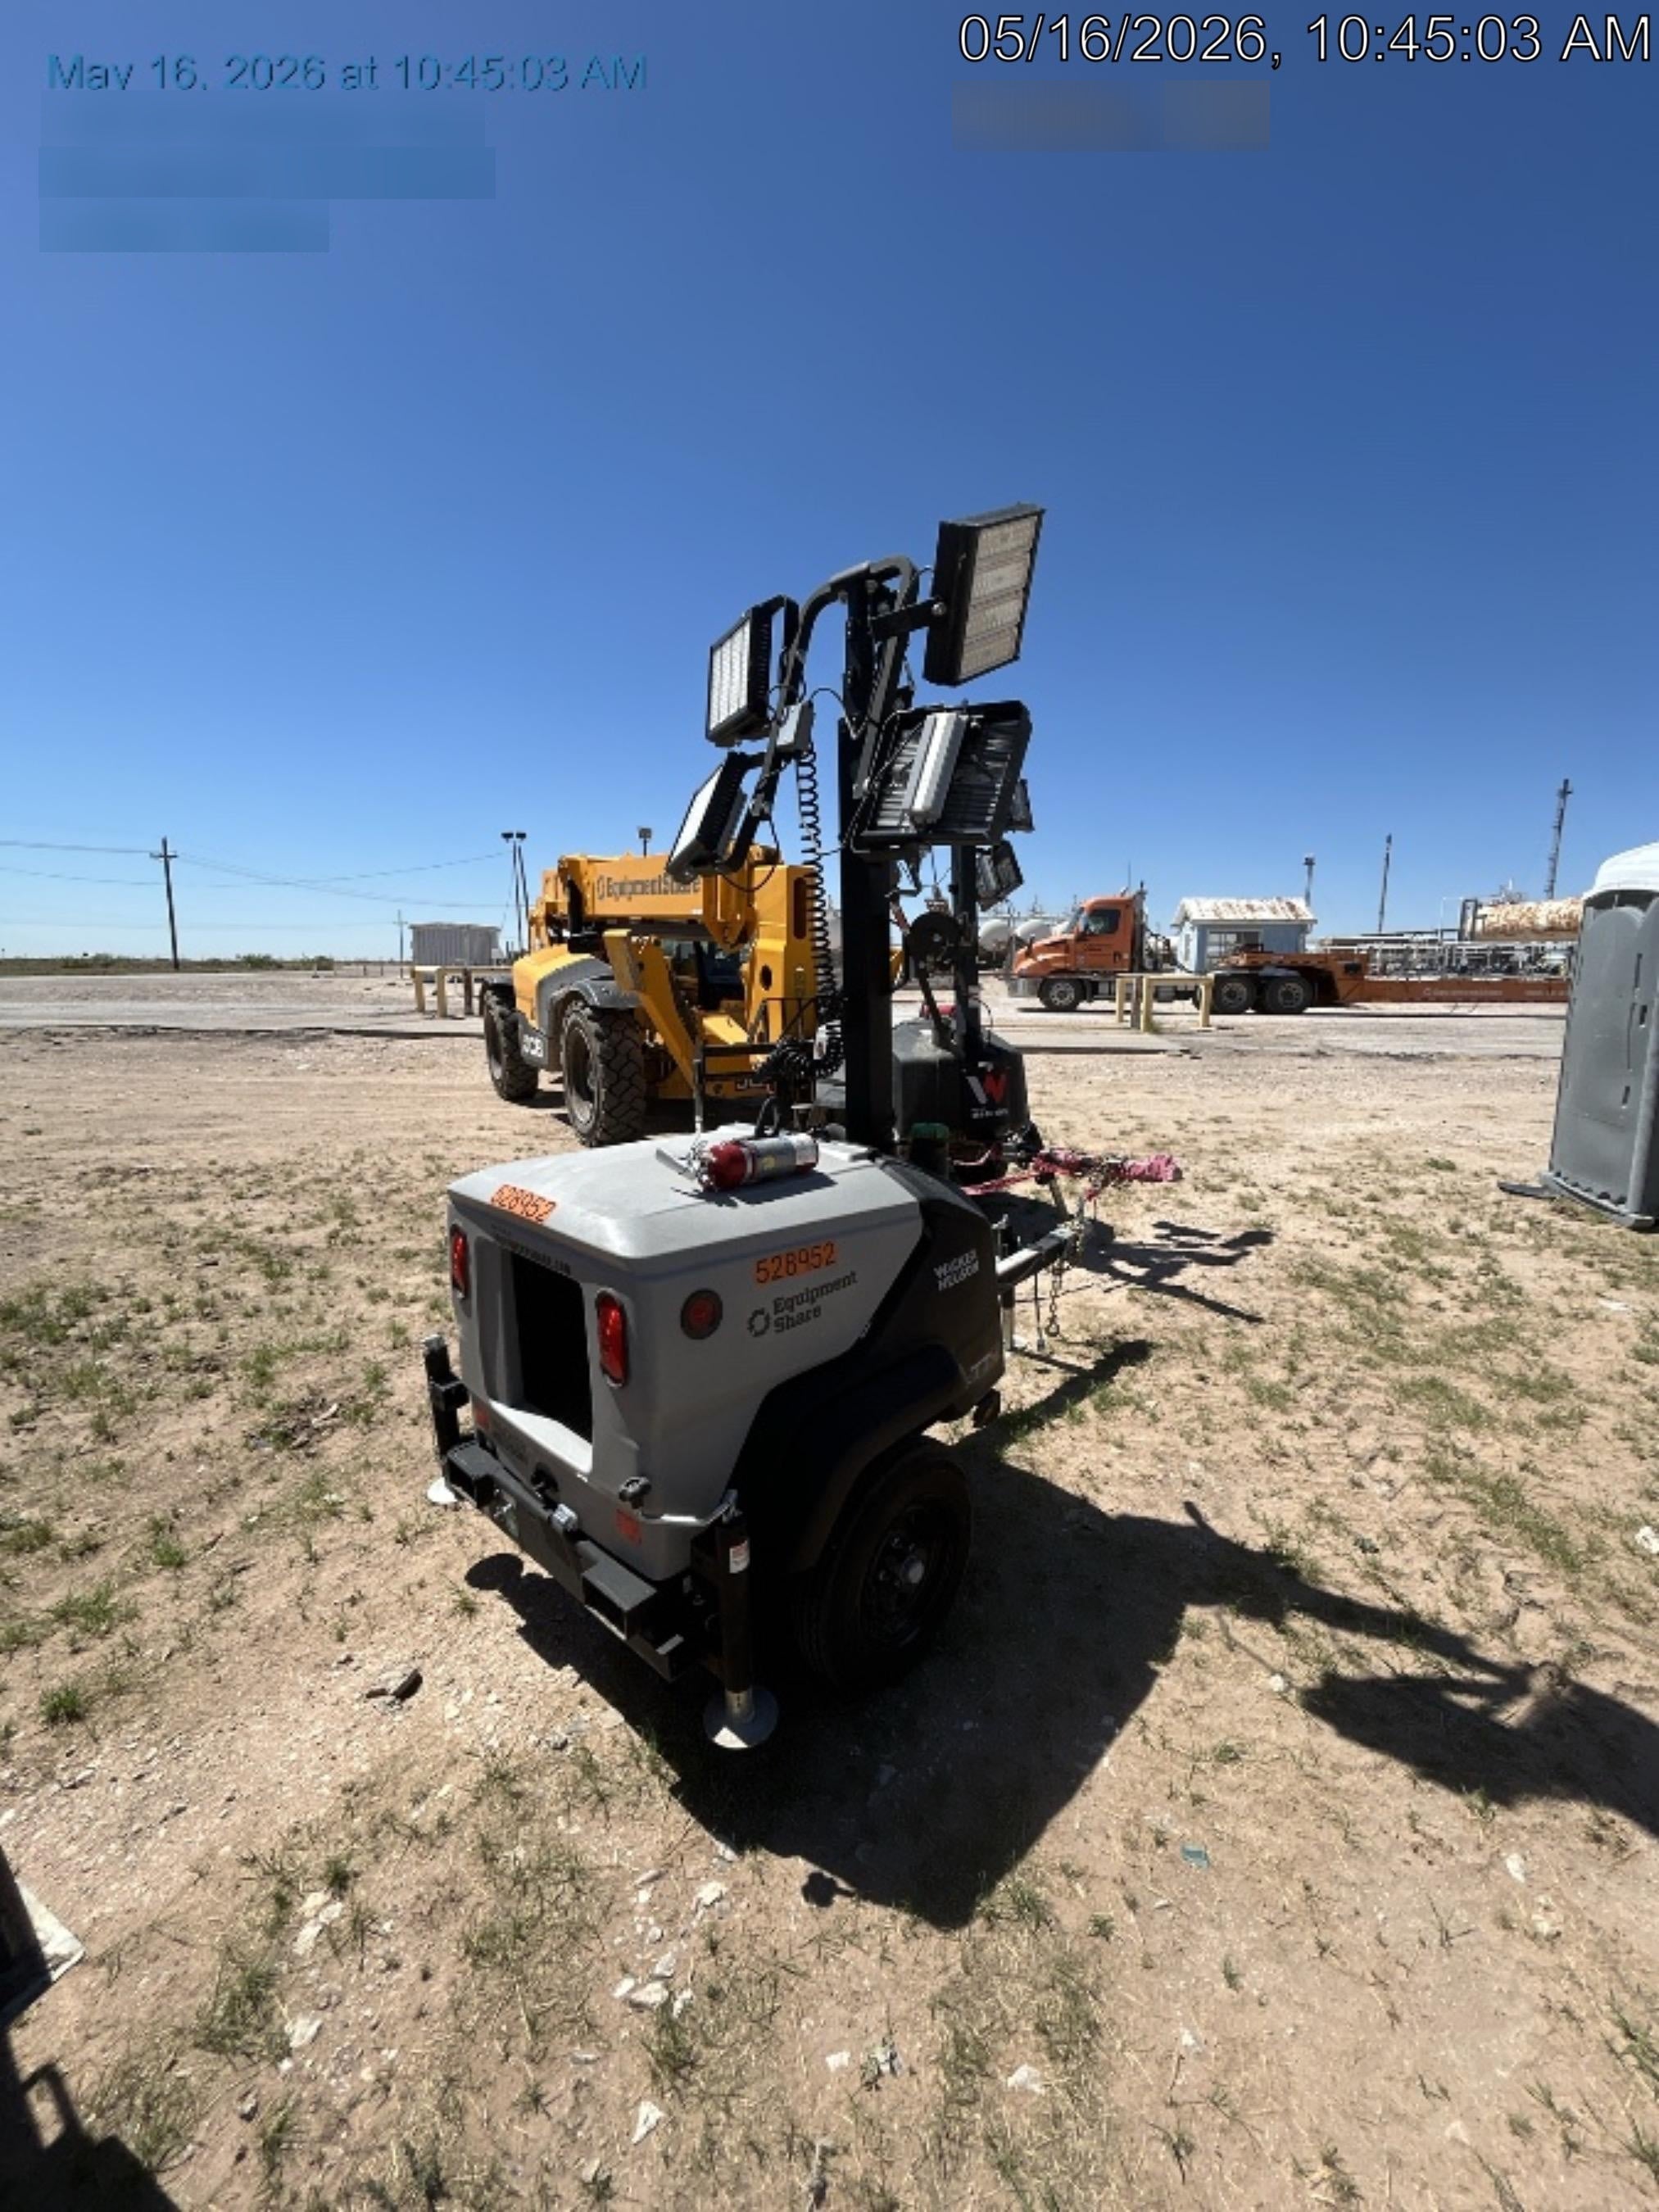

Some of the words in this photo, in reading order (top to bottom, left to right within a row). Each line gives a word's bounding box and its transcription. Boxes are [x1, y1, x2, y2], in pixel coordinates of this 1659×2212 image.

[755, 1240, 836, 1283] 528952
[773, 1271, 858, 1316] Equipment
[773, 1305, 822, 1334] Share
